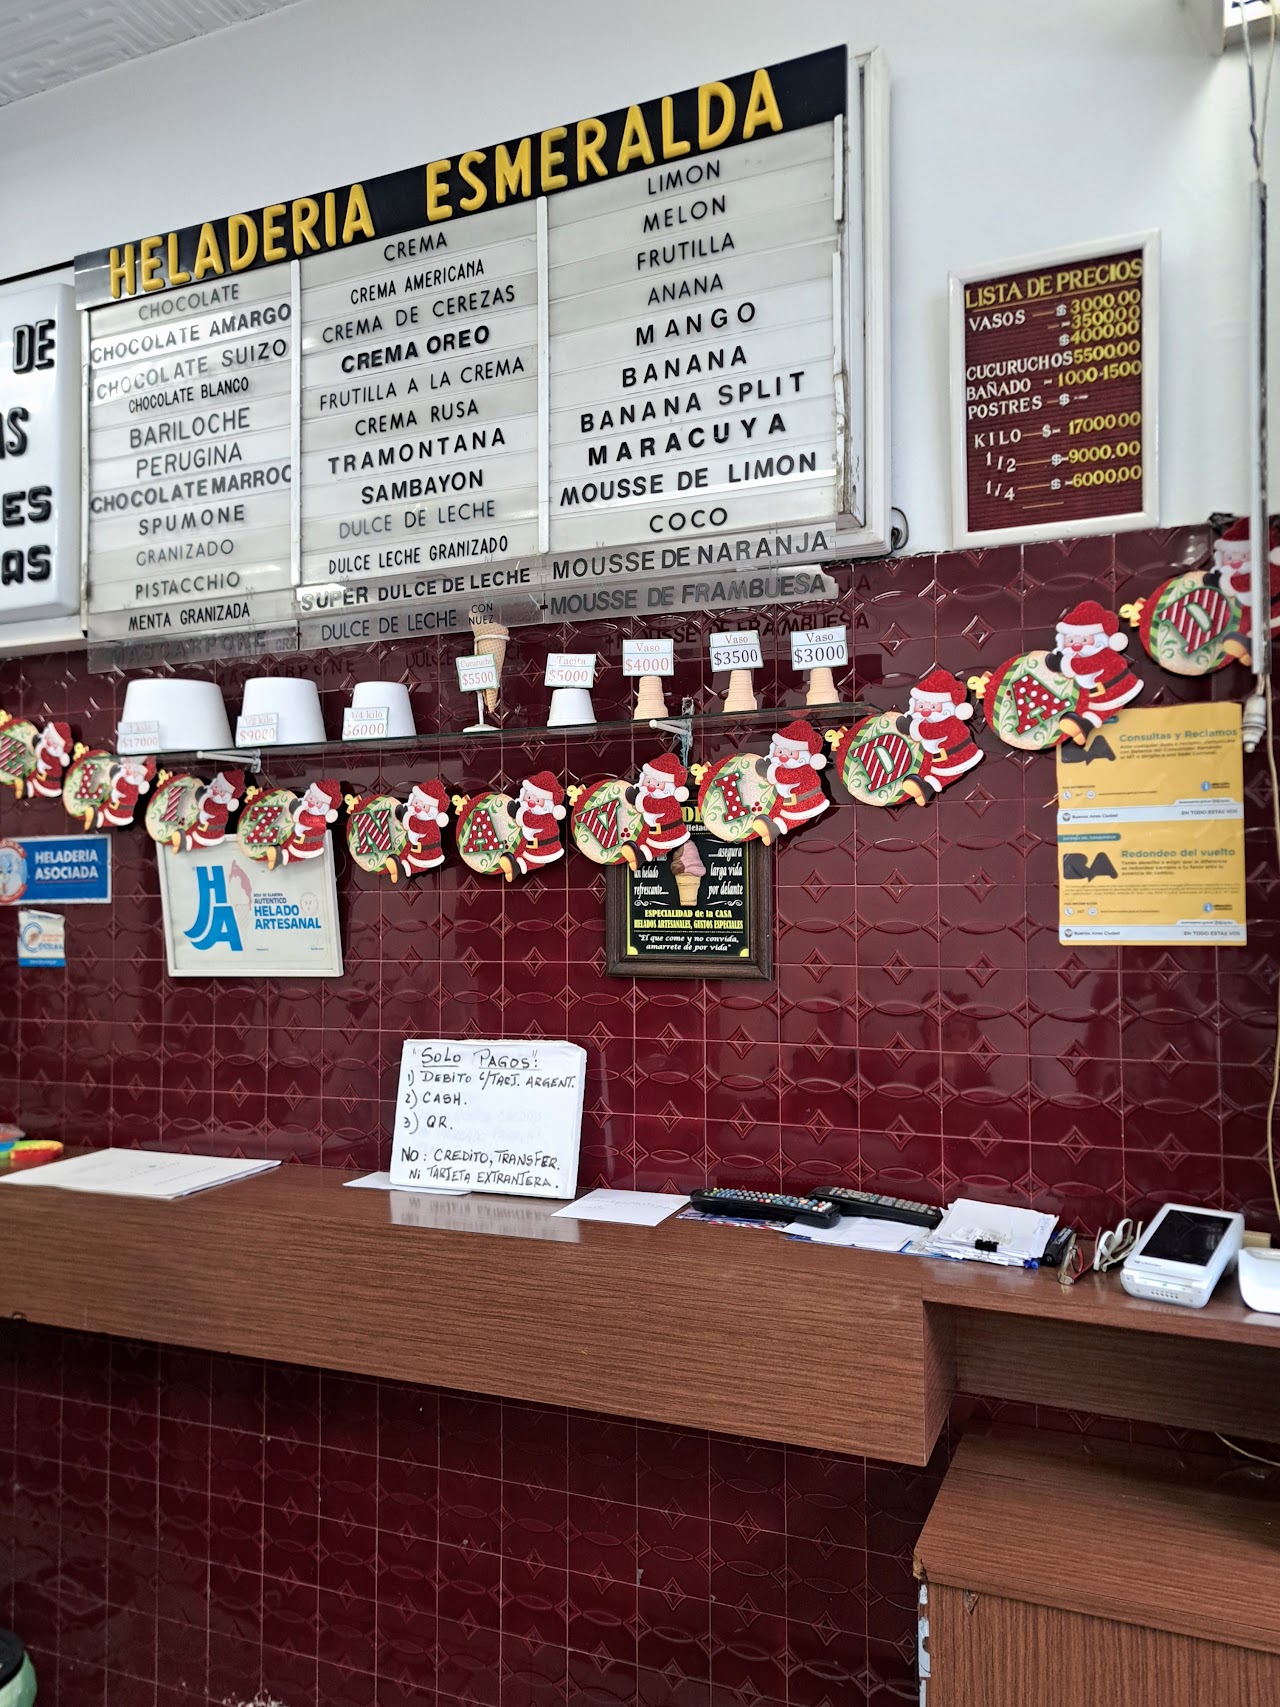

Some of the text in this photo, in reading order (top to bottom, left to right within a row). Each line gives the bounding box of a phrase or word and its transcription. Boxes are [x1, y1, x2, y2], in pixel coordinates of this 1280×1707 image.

[109, 68, 784, 299] HELADERIA ESMERALDA
[648, 159, 721, 195] LIMON
[643, 195, 727, 233] MELON
[384, 232, 448, 261] CREMA
[637, 232, 735, 271] FRUTILLA
[350, 258, 485, 305] CREMA AMERICANA
[648, 273, 724, 306] ANANA
[965, 258, 1143, 309] LISTA DE PRECIOS
[138, 283, 240, 320] CHOCOLATE
[322, 284, 516, 344] CREMA DE CEREZAS
[91, 303, 292, 365] CHOCOLATE AMARGO
[636, 302, 756, 347] MANGO
[969, 309, 1026, 332] VASOS
[12, 318, 56, 374] DE
[341, 325, 490, 373] CREMA OREO
[96, 338, 288, 400] CHOCOLATE SUIZO
[622, 345, 747, 388] BANANA
[966, 351, 1073, 381] CUCURUCHOS
[128, 376, 250, 414] CHOCOLATE BLANCO
[320, 356, 525, 412] FRUTILLA A LA CREMA
[966, 378, 1031, 402] BAÑADO
[580, 371, 805, 434] BANANA SPLIT
[968, 395, 1043, 421] POSTRES
[129, 406, 251, 449] BARILOCHE
[355, 399, 479, 437] CREMA RUSA
[328, 427, 506, 475] TRAMONTANA
[588, 413, 786, 467] MARACUYA
[974, 428, 1022, 449] KILO
[136, 441, 243, 479] PERUGINA
[361, 469, 484, 505] SAMBAYON
[560, 452, 817, 506] MOUSSE DE LIMON
[90, 479, 208, 515] CHOCOLATE
[138, 504, 245, 536] SPUMONE
[339, 500, 496, 540] DULCE DE LECHE
[649, 507, 728, 533] COCO
[136, 539, 234, 567] GRANIZADO
[328, 535, 508, 575] DULCE LECHE GRANIZADO
[552, 530, 829, 580] MOUSSE DE NARANJA
[135, 571, 241, 600] PISTACCHIO
[301, 567, 531, 612] SUPER DULCE DE LECHE
[550, 588, 637, 616] MOUSSE
[647, 586, 675, 608] DE
[681, 573, 827, 604] FRAMBUESA
[128, 601, 251, 632] MENTA GRANIZADA
[468, 614, 494, 626] NUEZ
[471, 603, 493, 614] CON
[321, 609, 457, 641] DULCE DE LECHE
[725, 635, 749, 644] Vaso
[805, 632, 834, 642] Vaso
[557, 655, 587, 666] Tacita
[635, 642, 661, 652] Vaso
[713, 649, 758, 666] $3500
[794, 645, 845, 664] $3000
[462, 671, 494, 686] $5500
[549, 670, 589, 683] $5000
[625, 657, 669, 672] $4000
[366, 709, 384, 719] kilo
[344, 722, 385, 738] $6000
[1120, 732, 1172, 743] Consultas
[1184, 729, 1237, 739] Reclamos
[35, 849, 98, 864] HELADERIA
[1121, 848, 1236, 858] Redondeo del vuelto
[35, 865, 99, 880] ASOCIADA
[254, 905, 300, 917] HELADO
[255, 917, 322, 930] ARTESANAL
[644, 909, 732, 918] ESPECIALIDAD de la CASA
[650, 935, 664, 944] que
[683, 942, 693, 951] de
[692, 944, 707, 953] por
[405, 1089, 467, 1110] 2) CASH.
[403, 1112, 419, 1134] 3)
[427, 1165, 560, 1189] TARJETA EXTRANJERA.
